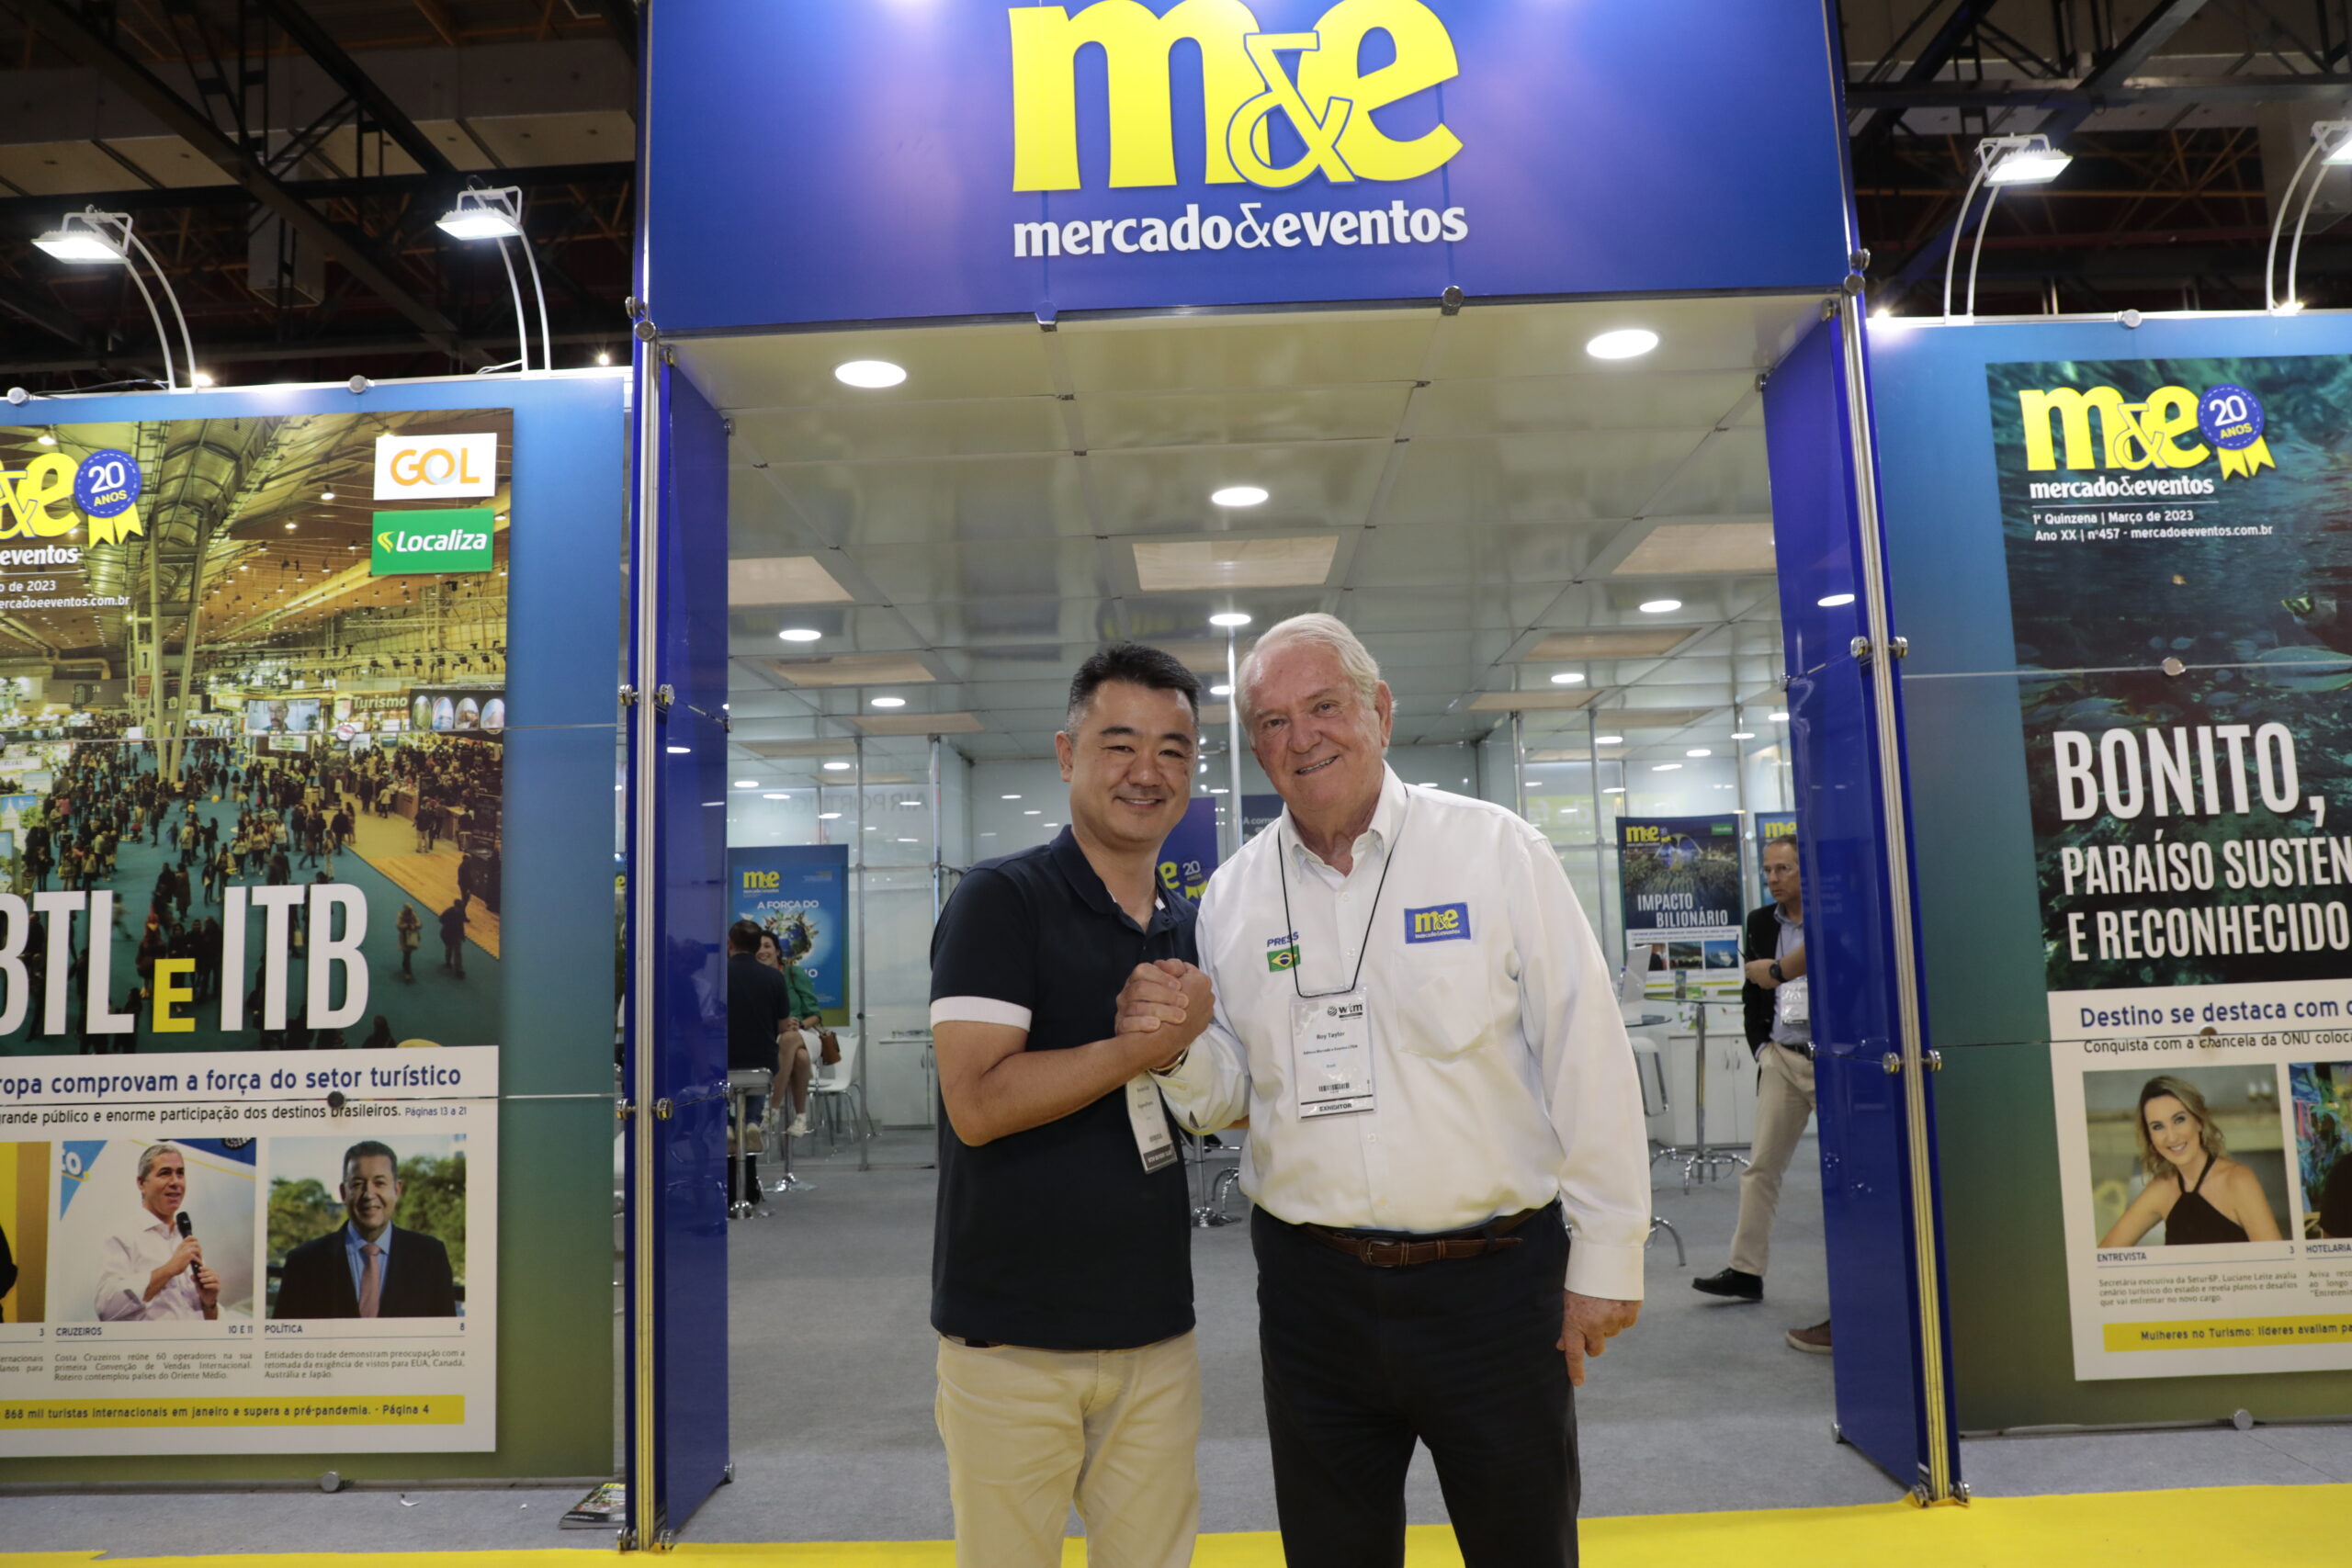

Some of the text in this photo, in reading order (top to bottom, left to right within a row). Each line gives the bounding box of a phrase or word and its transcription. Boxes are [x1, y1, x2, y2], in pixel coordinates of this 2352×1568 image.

[1008, 0, 1464, 191] m&e
[1013, 199, 1469, 257] mercado&eventos
[2210, 394, 2247, 426] 20
[2018, 385, 2211, 471] m&e
[2220, 423, 2253, 440] ANOS
[88, 461, 126, 493] 20
[390, 447, 480, 486] GOL
[94, 490, 128, 506] ANOS
[2030, 476, 2214, 499] mercado&eventos
[2045, 513, 2098, 525] Quinzena
[2109, 512, 2143, 525] Março
[2146, 511, 2161, 522] de
[2165, 510, 2194, 522] 2023
[396, 529, 487, 552] Localiza
[2035, 530, 2057, 541] Ano
[2061, 529, 2076, 540] XX
[2131, 525, 2273, 538] mercadoeeventos.com.br
[9, 581, 24, 592] de
[27, 581, 56, 592] 2023
[352, 694, 408, 710] Turismo
[2052, 722, 2325, 829] BONITO,
[1182, 861, 1201, 875] 20
[2061, 829, 2352, 896] PARAÍSO SUSTEN
[757, 900, 819, 910] A FORÇA DO
[1637, 893, 1693, 911] IMPACTO
[1415, 908, 1459, 933] m&e
[1657, 907, 1728, 928] BILIONÁRIO
[1267, 931, 1299, 947] PRESS
[2067, 901, 2350, 961] E RECONHECIDO
[153, 958, 196, 1032] E
[220, 884, 369, 1032] ITB
[2080, 1005, 2163, 1028] Destino
[2171, 1007, 2195, 1023] se
[2202, 1003, 2286, 1022] destaca
[2294, 1001, 2339, 1018] com
[2084, 1039, 2148, 1055] Conquista
[2154, 1039, 2182, 1050] com
[2187, 1039, 2194, 1049] a
[2199, 1033, 2256, 1049] chancela
[2261, 1033, 2277, 1046] da
[2282, 1032, 2310, 1045] ONU
[51, 1074, 177, 1098] comprovam
[187, 1075, 198, 1090] a
[207, 1069, 261, 1095] força
[270, 1068, 296, 1089] do
[306, 1067, 362, 1089] setor
[371, 1064, 461, 1087] turístico
[42, 1109, 89, 1126] público
[94, 1111, 101, 1122] e
[107, 1111, 155, 1122] enorme
[161, 1106, 239, 1124] participação
[244, 1107, 267, 1120] dos
[272, 1104, 326, 1119] destinos
[405, 1106, 437, 1118] Páginas
[440, 1107, 447, 1116] 13
[458, 1106, 467, 1115] 21
[2097, 1252, 2146, 1262] ENTREVISTA
[2306, 1244, 2352, 1254] HOTELARIA
[56, 1327, 102, 1337] CRUZEIROS
[229, 1325, 236, 1334] 10
[240, 1325, 244, 1334] E
[265, 1323, 303, 1333] POLÍTICA
[2141, 1324, 2337, 1341] Mulheres no Turismo: líderes avaliam
[84, 1353, 120, 1361] Cruzeiros
[173, 1352, 216, 1361] operadores
[5, 1409, 23, 1418] 868
[28, 1408, 44, 1418] mil
[48, 1408, 88, 1418] turistas
[93, 1407, 167, 1417] internacionais
[172, 1407, 188, 1416] em
[191, 1406, 228, 1419] janeiro
[243, 1406, 280, 1417] supera
[284, 1406, 289, 1415] a
[294, 1404, 370, 1417] pré-pandemia.
[382, 1404, 418, 1416] Página
[423, 1404, 429, 1414] 4
